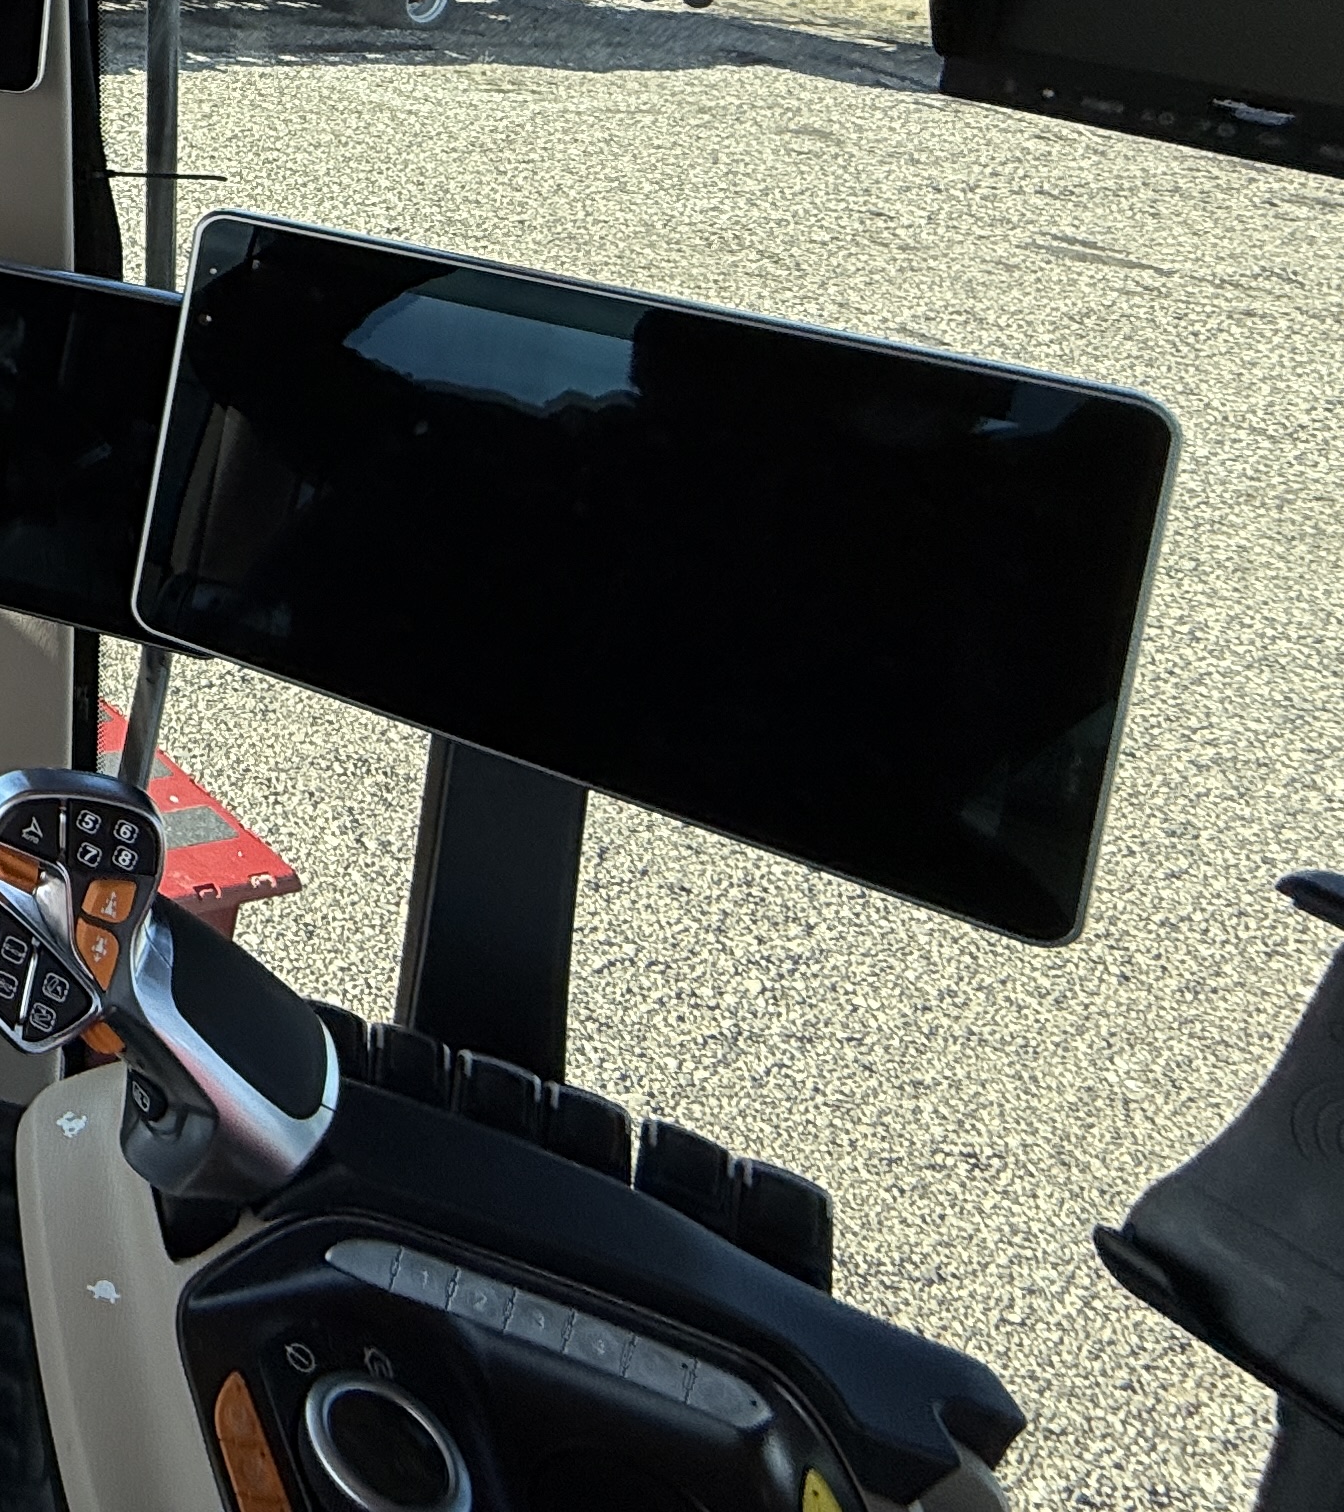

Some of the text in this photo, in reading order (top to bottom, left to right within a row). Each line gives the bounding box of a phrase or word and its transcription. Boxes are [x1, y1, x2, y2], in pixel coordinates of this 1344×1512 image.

[81, 814, 133, 839] 5 6
[83, 846, 132, 866] 7 8
